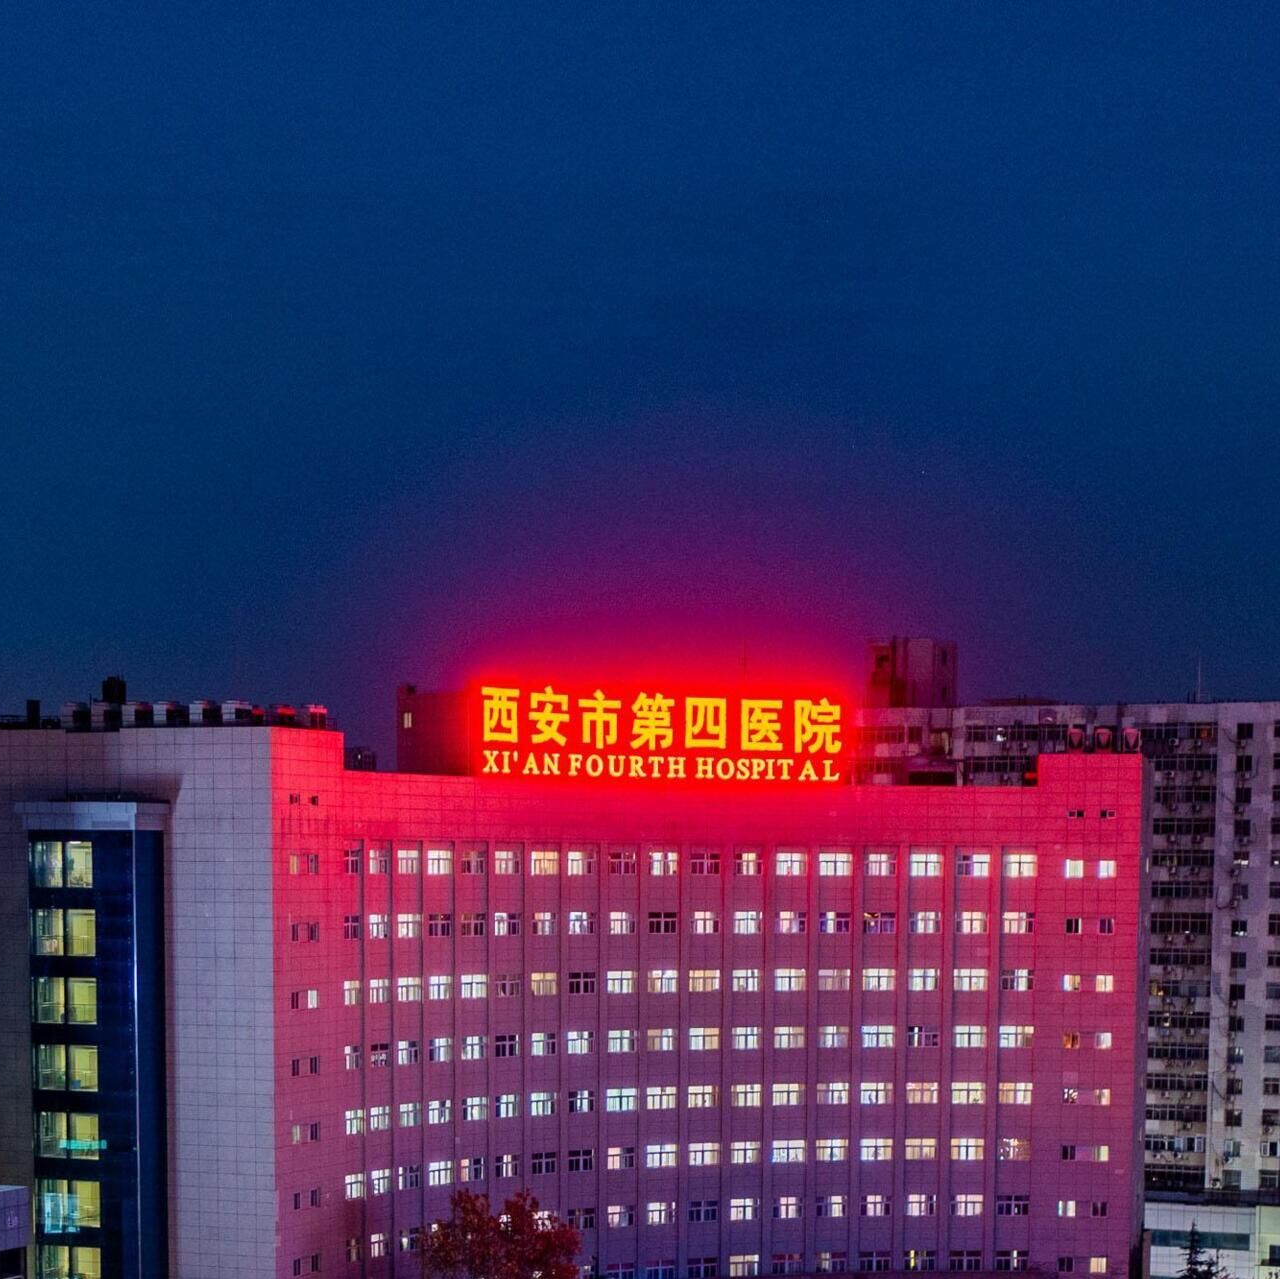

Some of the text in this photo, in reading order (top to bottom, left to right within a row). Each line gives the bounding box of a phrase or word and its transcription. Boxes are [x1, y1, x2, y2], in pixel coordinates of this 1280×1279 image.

[481, 686, 842, 753] 西安市第四医院
[483, 750, 840, 781] XI'AN FOURTH HOSPITAL
